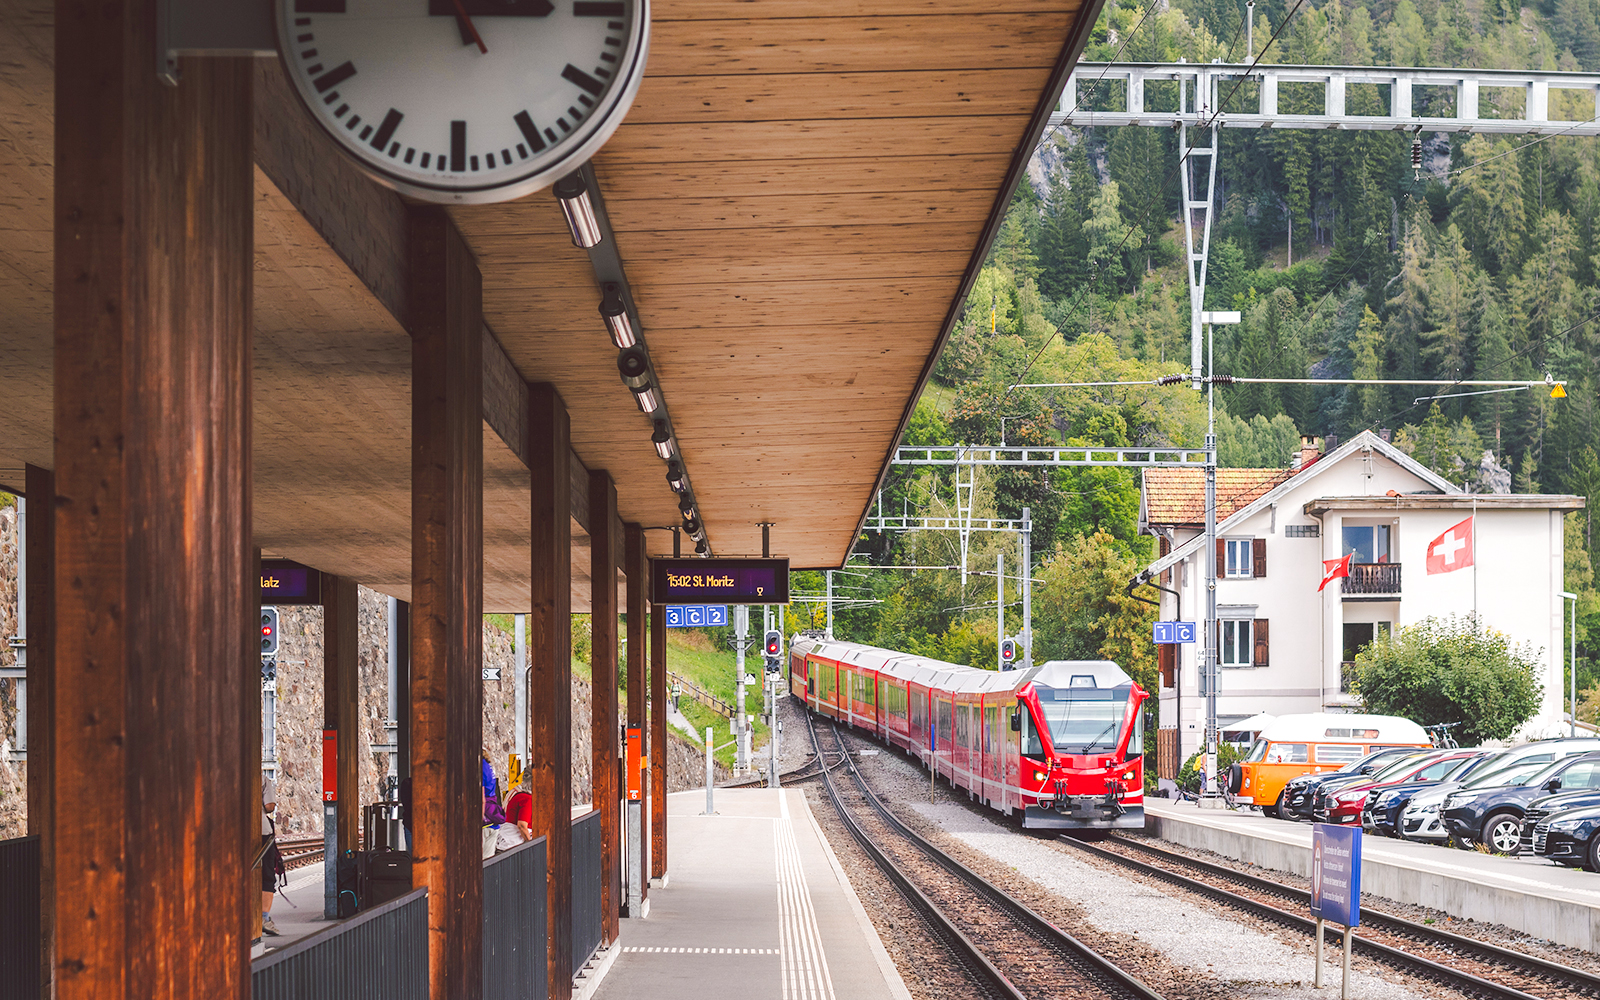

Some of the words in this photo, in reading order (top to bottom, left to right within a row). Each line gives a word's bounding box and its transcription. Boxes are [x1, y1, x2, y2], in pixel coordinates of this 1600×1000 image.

[260, 576, 280, 588] latz
[668, 574, 692, 588] 15:02
[693, 575, 705, 588] St.
[706, 575, 735, 588] Moritz
[669, 612, 679, 624] 3
[690, 611, 700, 623] C
[712, 611, 721, 622] 2
[1160, 628, 1166, 640] 1
[1180, 628, 1190, 640] C
[482, 669, 489, 679] S
[326, 793, 333, 801] 6
[631, 792, 638, 800] 6
